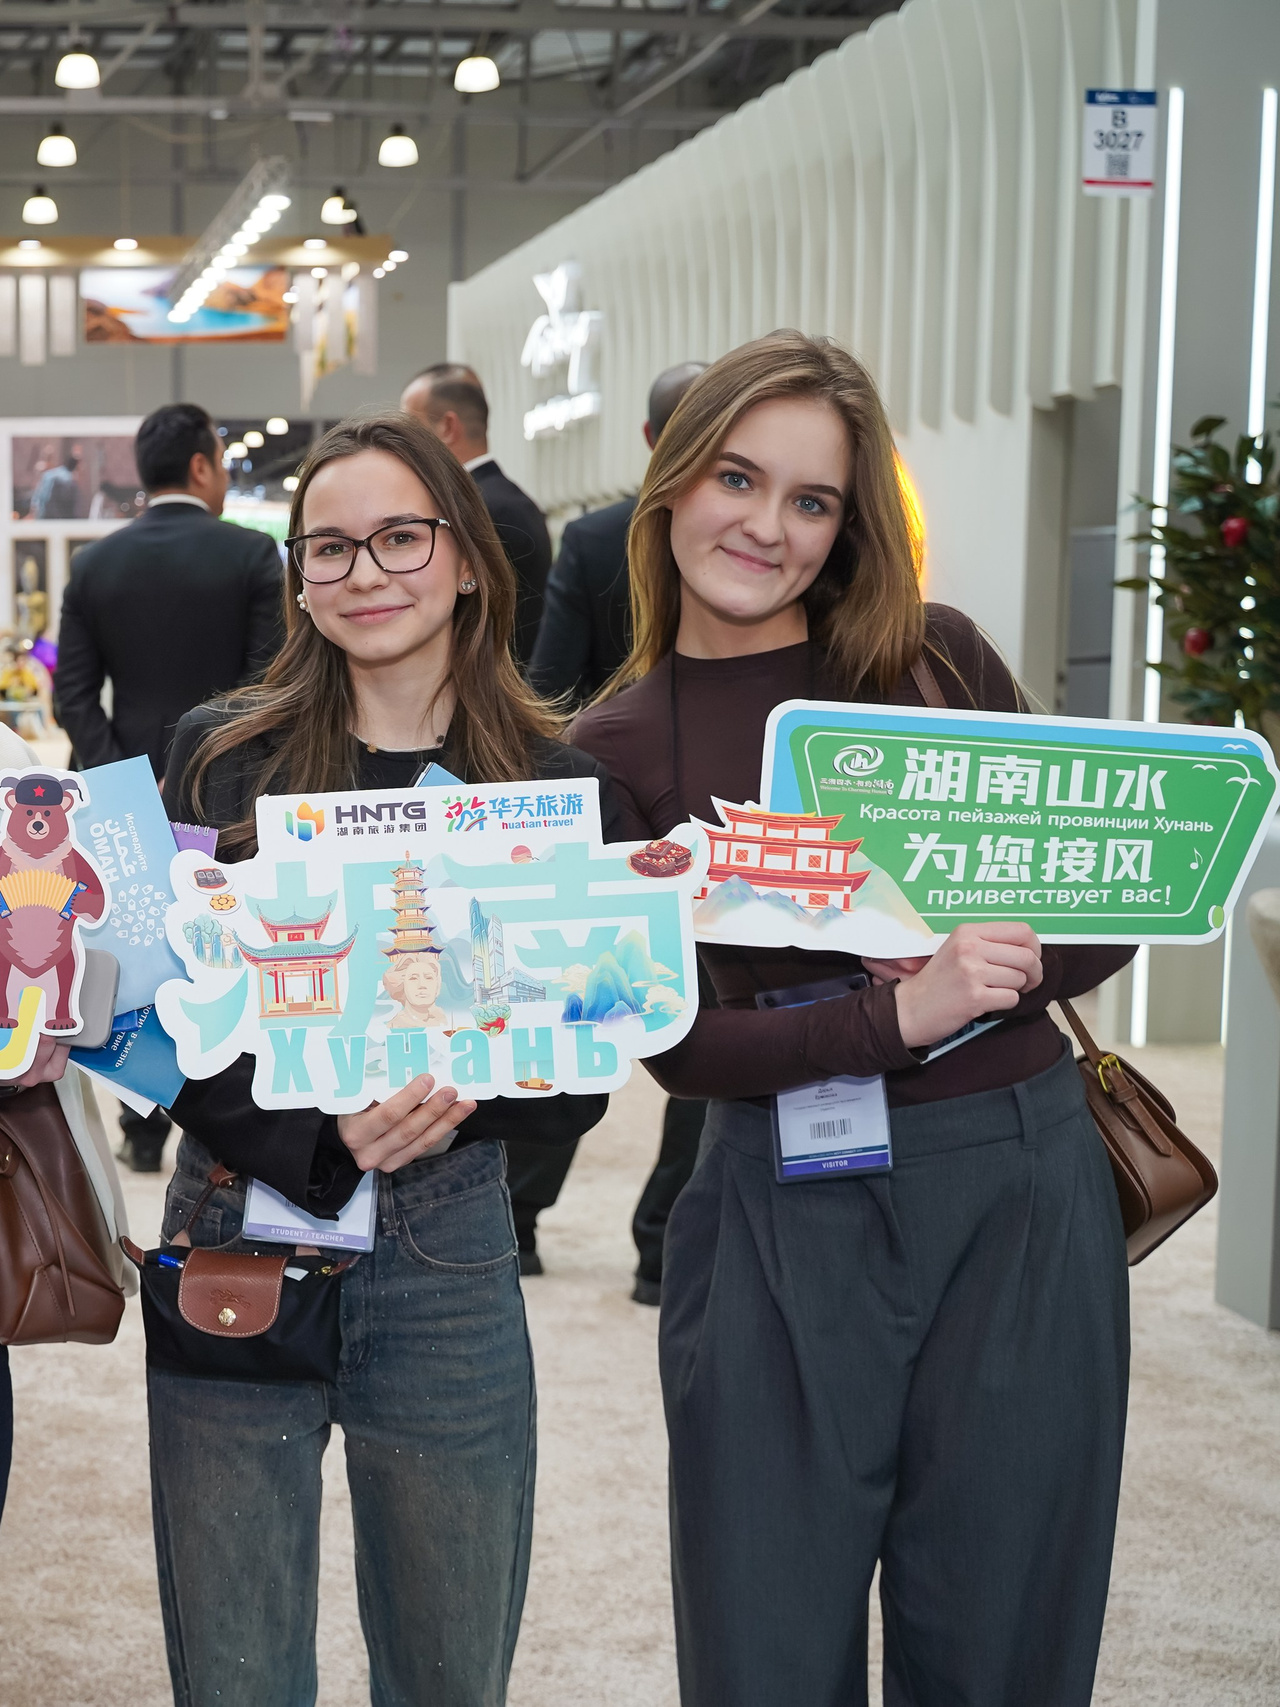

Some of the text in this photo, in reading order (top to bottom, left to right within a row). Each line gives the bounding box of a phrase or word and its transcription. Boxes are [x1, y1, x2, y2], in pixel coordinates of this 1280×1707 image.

[1111, 109, 1127, 129] B
[1093, 129, 1144, 151] 3027
[898, 747, 1168, 811] 湖南山水
[335, 801, 426, 824] HNTG
[489, 793, 583, 819] 华天旅游
[336, 822, 427, 836] 湖南旅游集团
[502, 818, 574, 830] huatian travel
[860, 804, 1214, 834] Красота пейзажей провинции Хунань
[89, 822, 120, 883] ОМАН
[124, 812, 148, 872] Исследуйте
[902, 833, 1153, 883] 为您接风
[927, 885, 1171, 909] приветствует вас!
[115, 1040, 134, 1068] жизнь
[267, 1025, 618, 1099] Хунань
[822, 1160, 848, 1169] VISITOR
[270, 1228, 303, 1238] STUDENT
[311, 1232, 345, 1243] TEACHER
